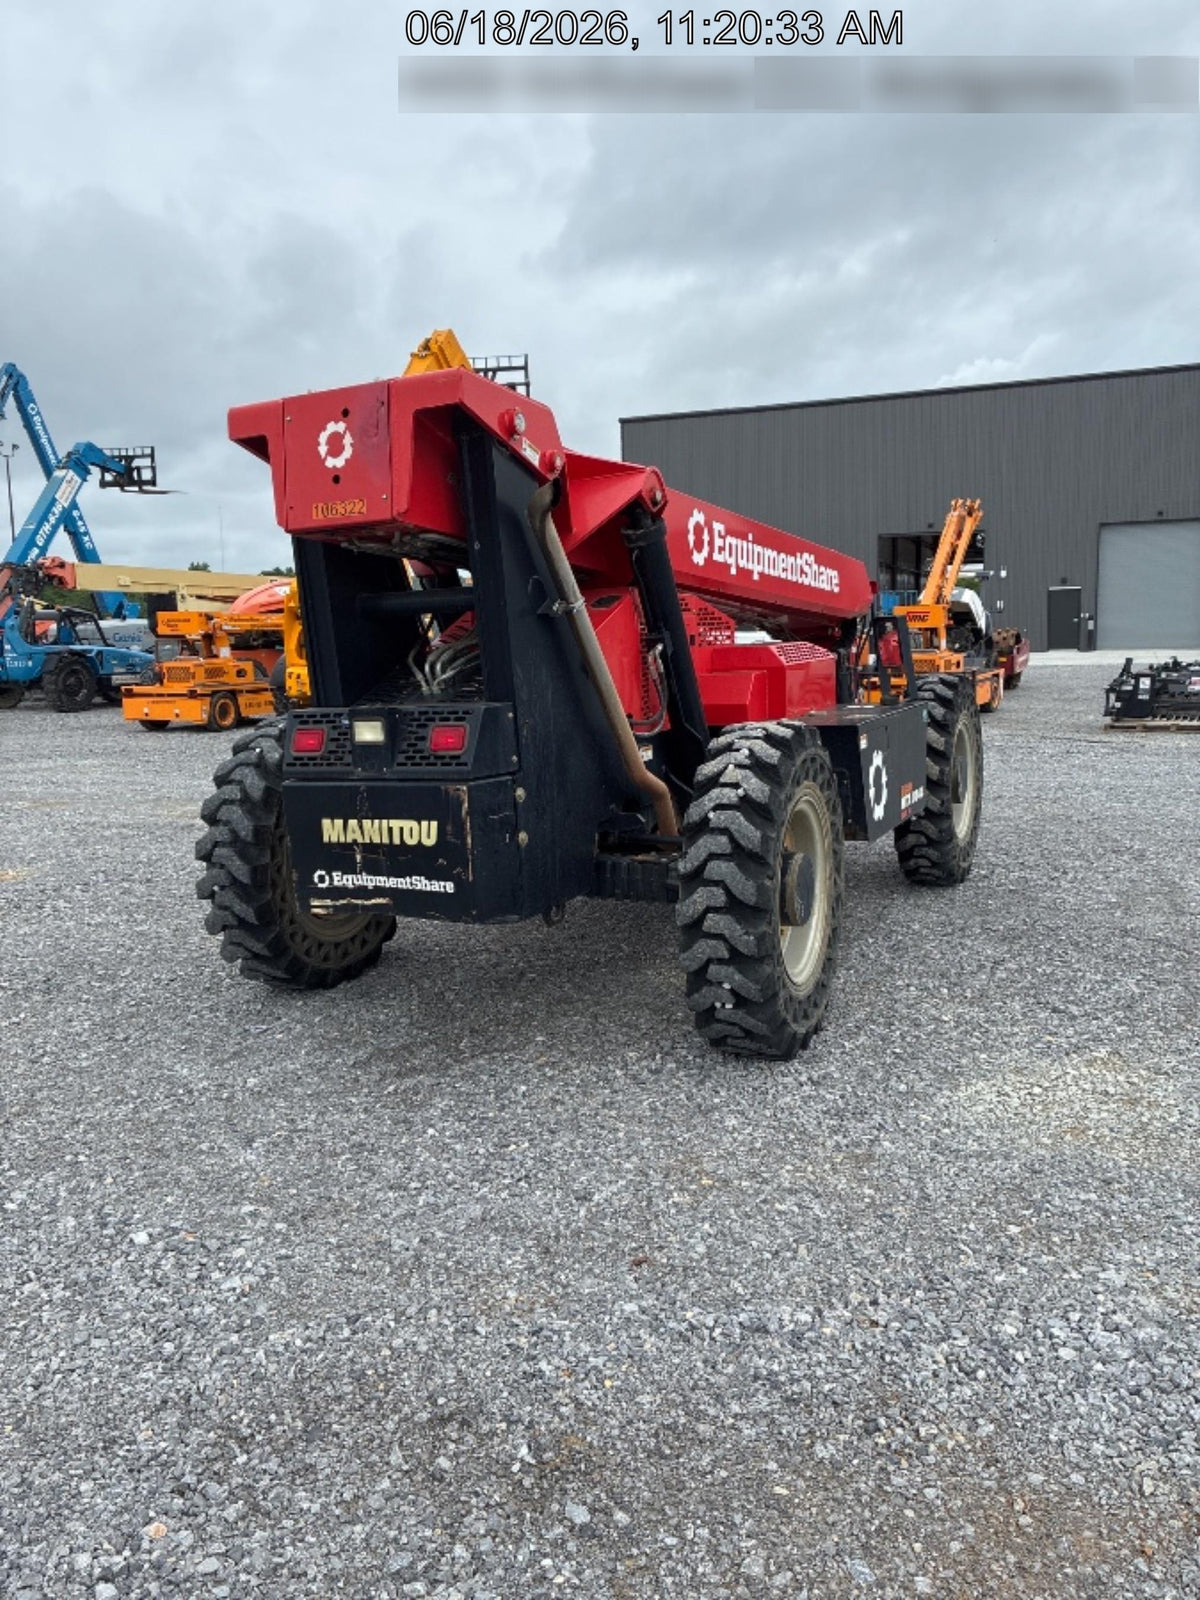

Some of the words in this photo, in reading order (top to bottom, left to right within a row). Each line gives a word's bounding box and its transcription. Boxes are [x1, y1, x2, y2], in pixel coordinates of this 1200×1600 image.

[313, 499, 365, 518] 106322
[712, 520, 840, 593] EquipmentShare
[321, 818, 438, 847] MANITOU
[332, 871, 455, 893] EquipmentShare
